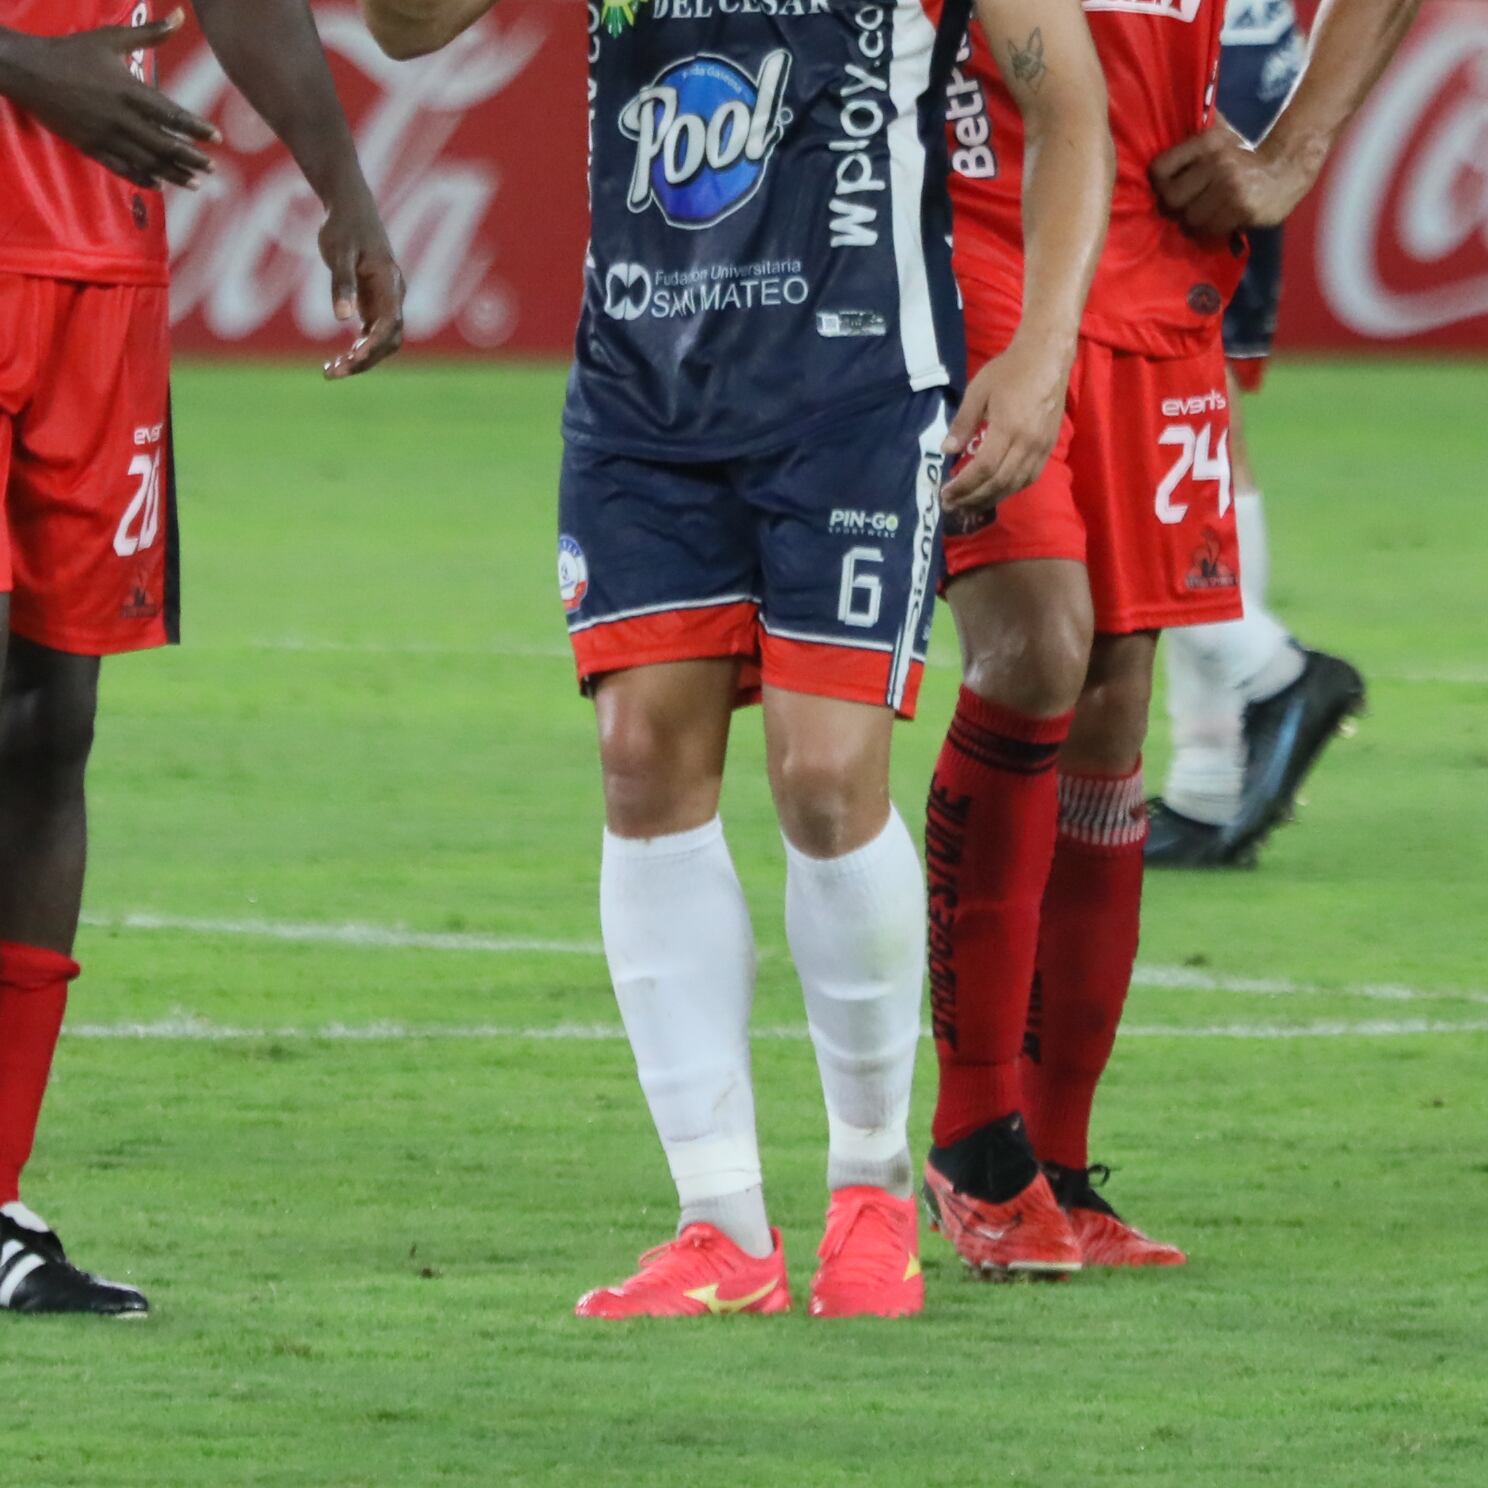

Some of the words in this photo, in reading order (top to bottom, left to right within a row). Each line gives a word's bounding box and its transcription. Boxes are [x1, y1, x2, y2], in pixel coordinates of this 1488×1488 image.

[619, 50, 792, 212] Pool
[700, 276, 809, 311] MATEO
[1154, 422, 1232, 525] 24
[829, 509, 898, 531] PIN-GO
[837, 546, 884, 628] 6
